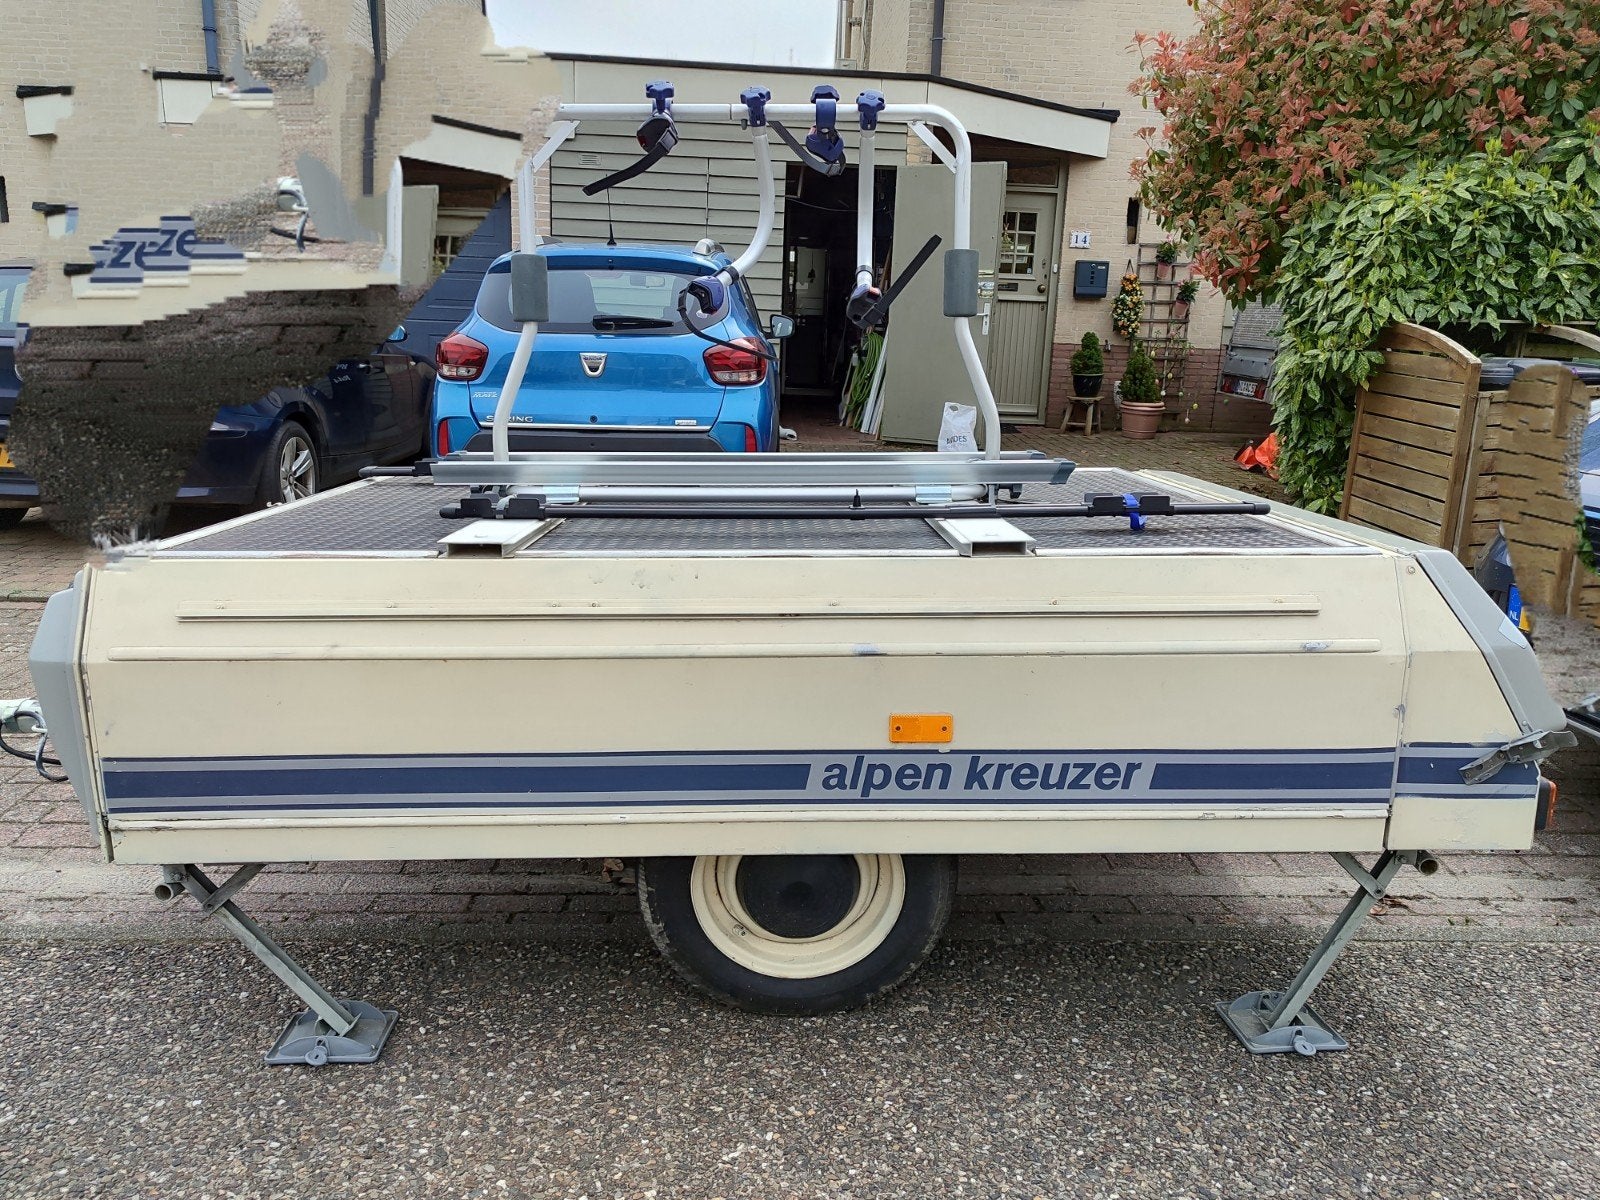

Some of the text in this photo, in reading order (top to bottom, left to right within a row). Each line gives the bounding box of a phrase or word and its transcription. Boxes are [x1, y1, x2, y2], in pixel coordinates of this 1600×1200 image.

[1074, 234, 1088, 245] 14
[1509, 611, 1518, 620] NL
[821, 755, 1143, 798] alpen kreuzer
